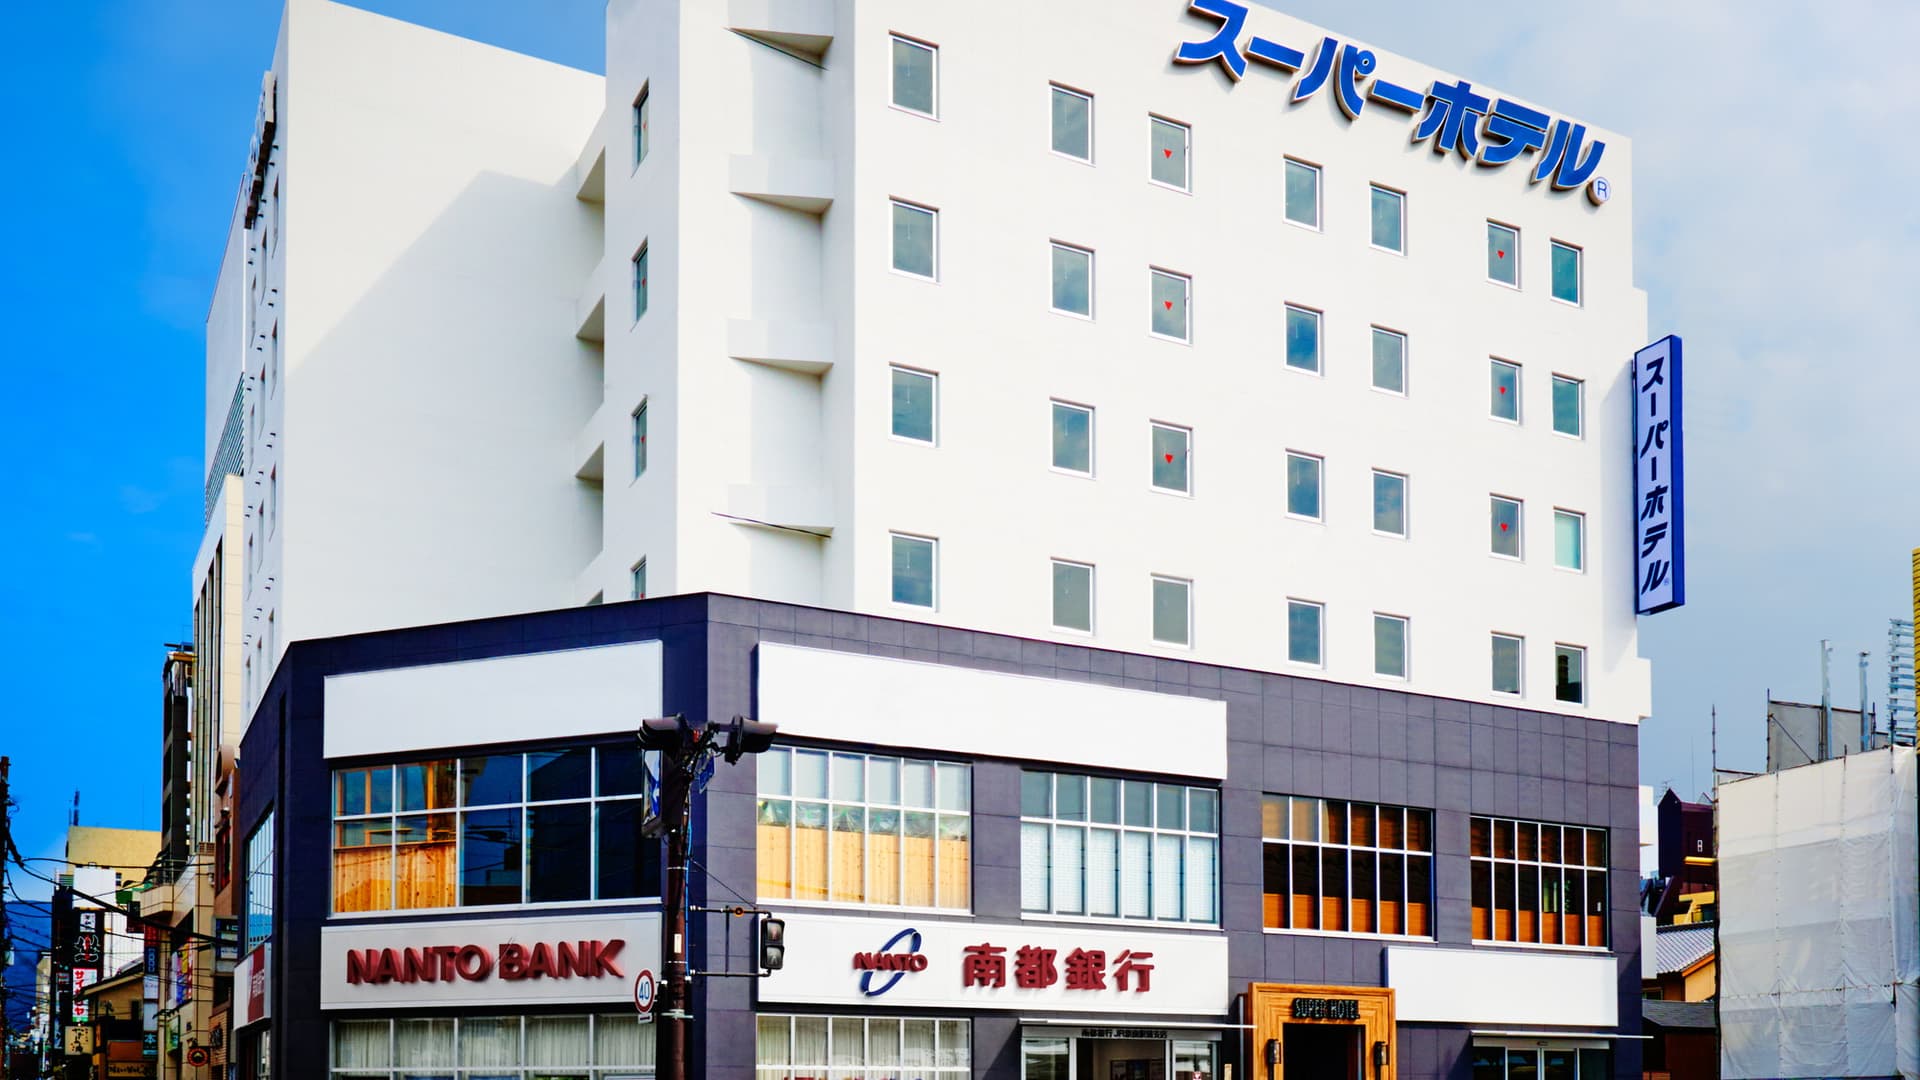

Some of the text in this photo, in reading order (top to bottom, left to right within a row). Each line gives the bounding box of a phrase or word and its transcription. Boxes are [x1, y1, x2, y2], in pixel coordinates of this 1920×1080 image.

[1174, 0, 1605, 190] スーパーホテル
[1640, 356, 1670, 595] スーパーホテル
[346, 939, 625, 985] NANTO BANK
[853, 950, 928, 973] NANTO
[962, 942, 1155, 993] 南都銀行
[639, 979, 652, 1002] 40
[1294, 998, 1327, 1018] SUPER
